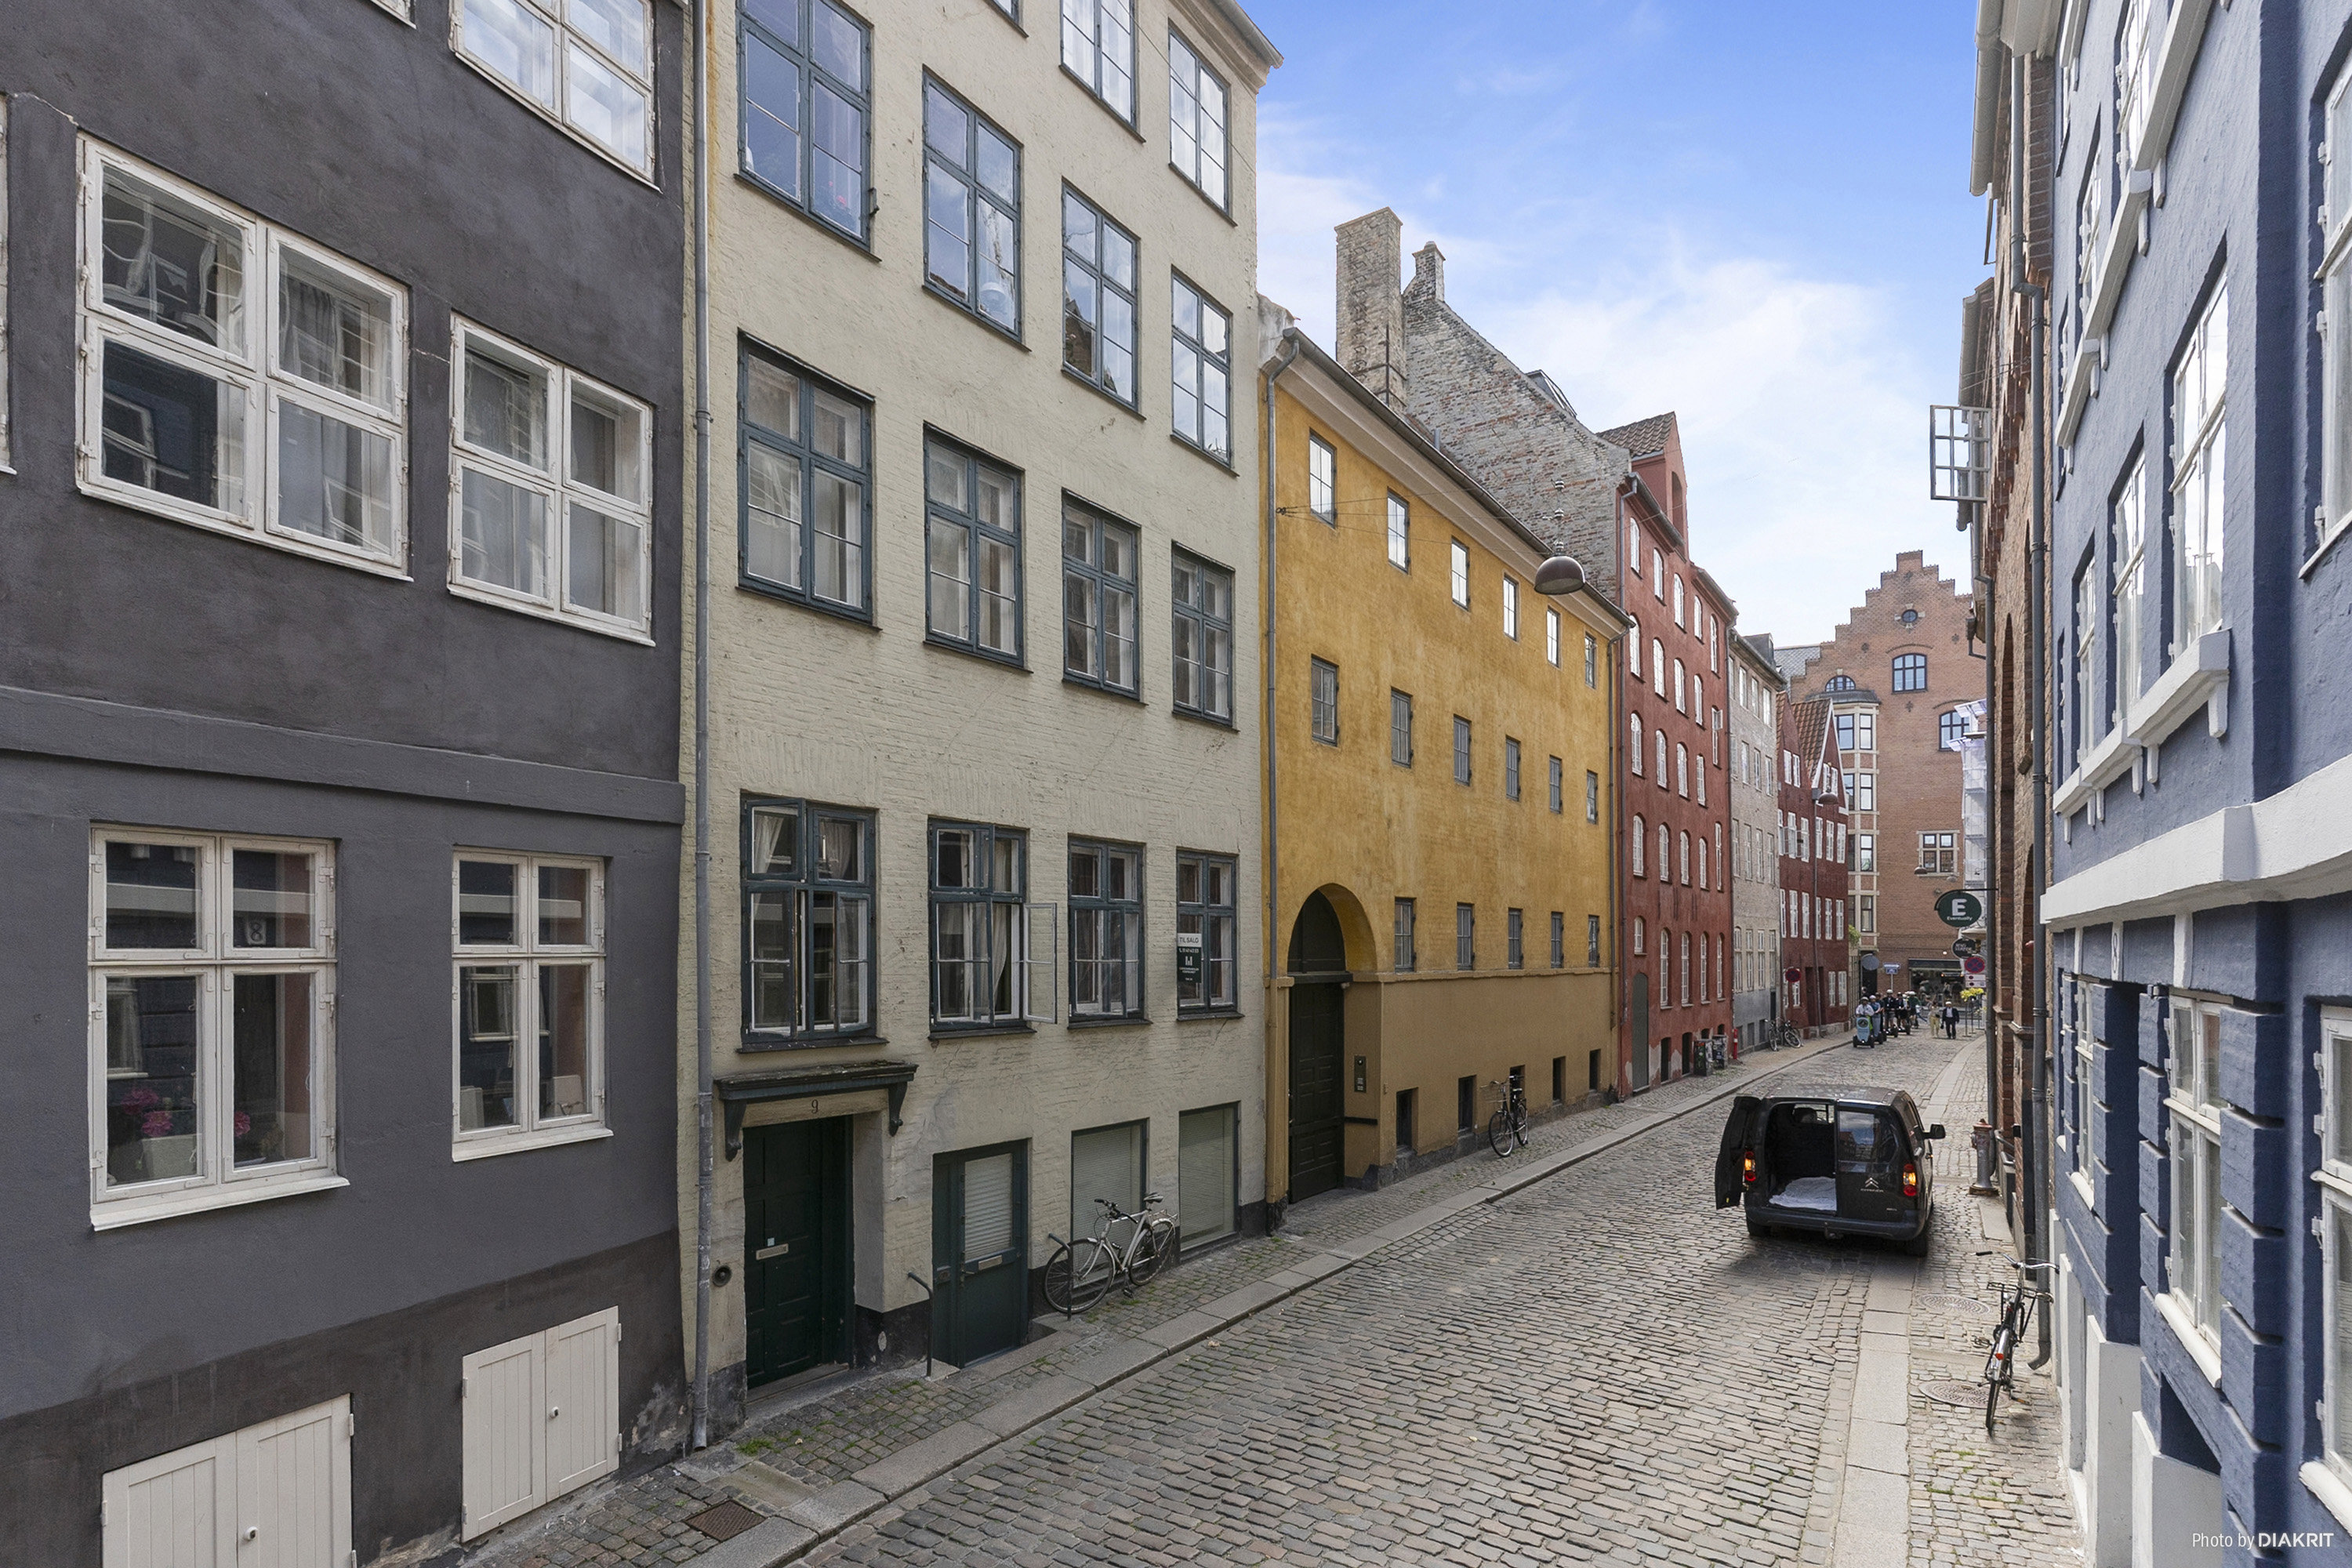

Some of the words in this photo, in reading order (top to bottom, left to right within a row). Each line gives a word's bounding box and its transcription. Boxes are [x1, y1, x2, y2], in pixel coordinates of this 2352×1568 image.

[1952, 898, 1967, 916] E
[2113, 932, 2118, 974] 8
[811, 1099, 818, 1114] 9
